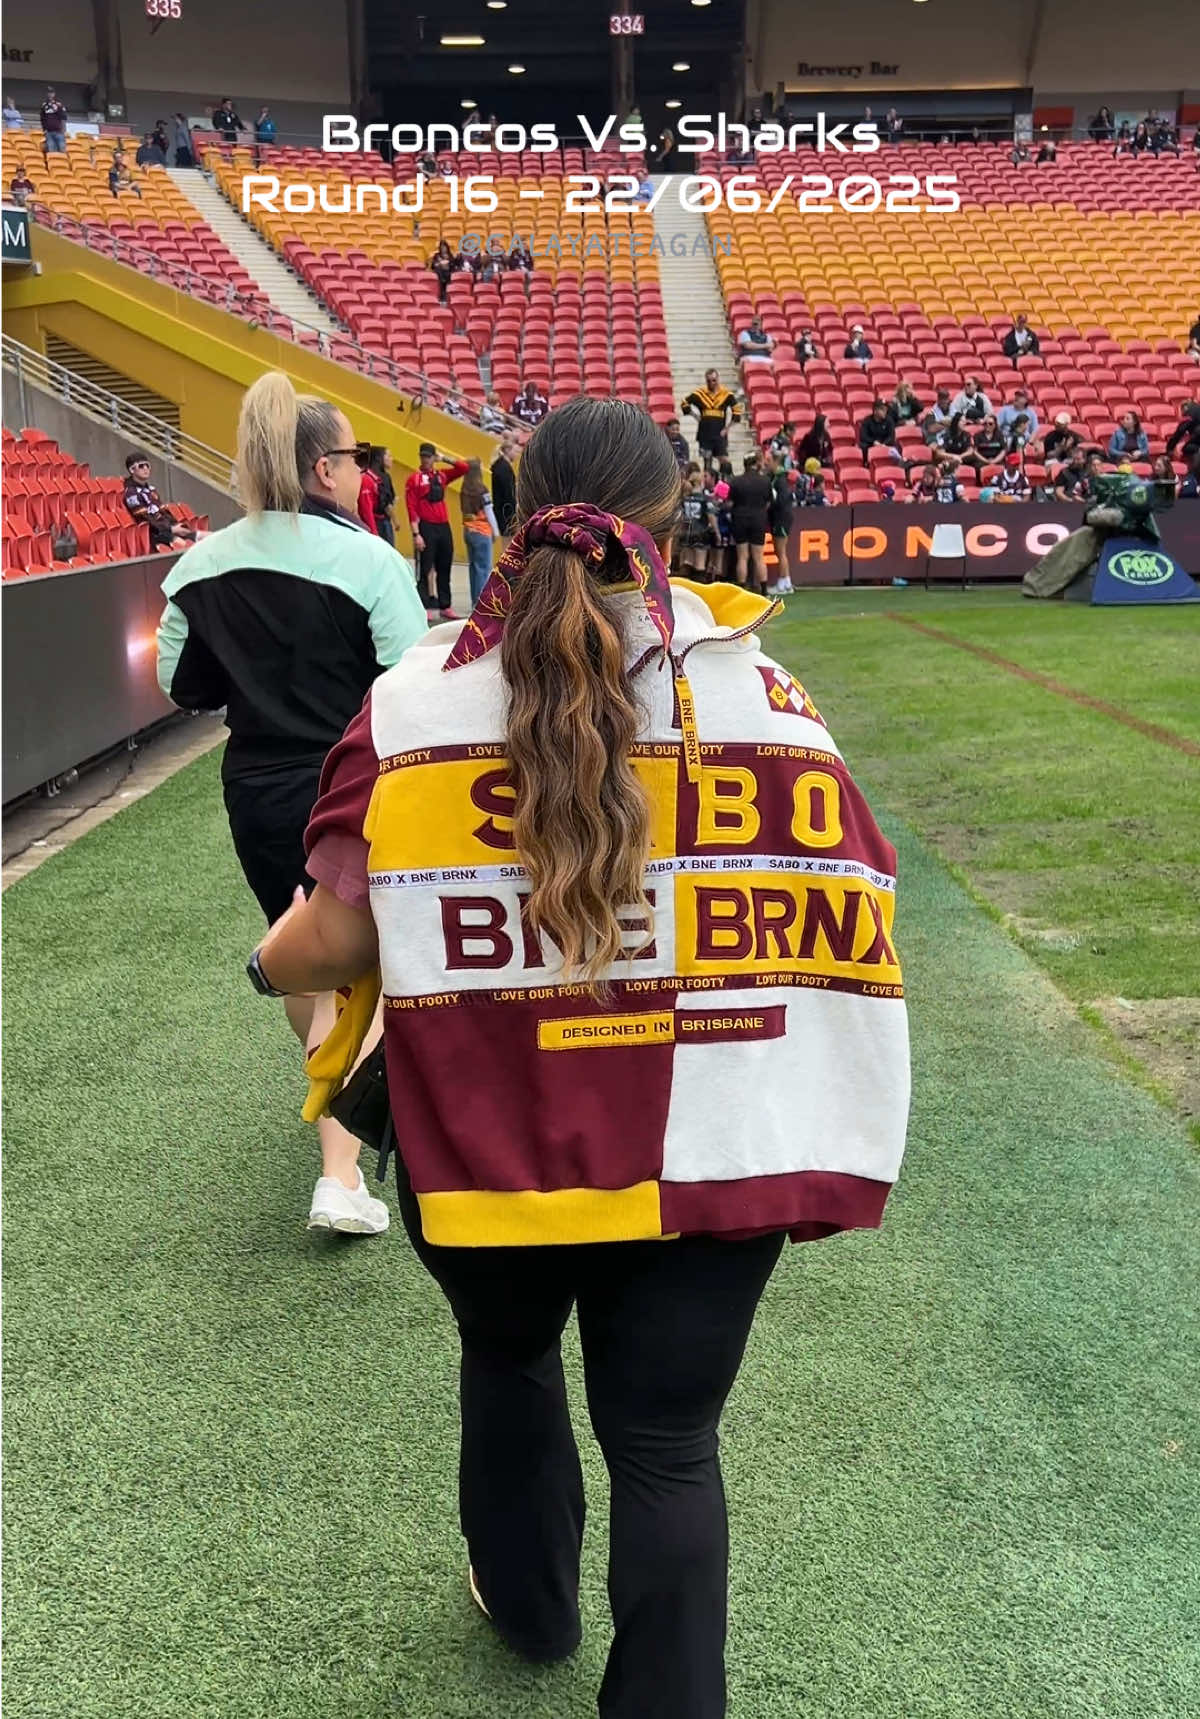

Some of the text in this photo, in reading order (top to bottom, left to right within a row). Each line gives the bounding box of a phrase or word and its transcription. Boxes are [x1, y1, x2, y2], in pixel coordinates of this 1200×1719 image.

[147, 0, 181, 18] 335
[610, 15, 644, 34] 334
[870, 61, 898, 75] Bar
[681, 698, 698, 766] BNE BRNX
[393, 750, 432, 767] FOOTY
[467, 745, 502, 757] LOVE
[653, 745, 680, 755] OUR
[700, 745, 724, 755] OTY
[756, 746, 786, 757] LOVE
[788, 747, 807, 759] OUR
[809, 750, 836, 765] FOOTY
[396, 874, 406, 884] X
[411, 872, 437, 883] BNE
[442, 869, 477, 881] BRNX
[499, 866, 527, 877] SAB
[678, 860, 687, 869] X
[691, 859, 717, 869] BNE
[723, 858, 753, 868] BRNX
[769, 858, 800, 869] SABO
[804, 862, 814, 871] X
[818, 863, 840, 873] BNE
[844, 864, 864, 876] BRN
[694, 887, 898, 965] BRNX
[625, 980, 658, 992] LOVE
[660, 979, 684, 989] OUR
[686, 977, 726, 989] FOOTY
[795, 975, 831, 987] FOOTY
[862, 984, 893, 996] LOVE
[392, 999, 416, 1009] OUR
[419, 993, 459, 1008] FOOTY
[493, 990, 526, 1001] LOVE
[529, 988, 554, 999] OUR
[558, 984, 592, 997] FOOTY
[562, 1018, 765, 1039] DESIGNED IN BRISBANE
